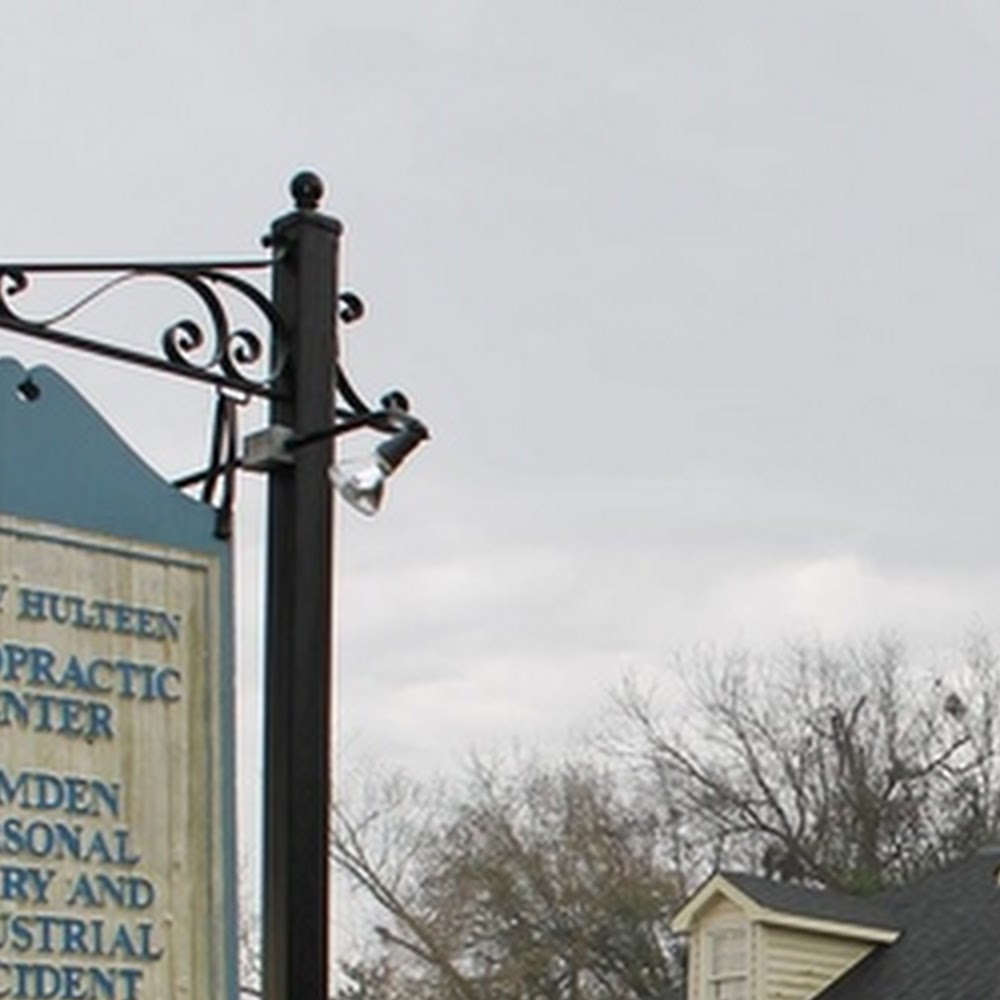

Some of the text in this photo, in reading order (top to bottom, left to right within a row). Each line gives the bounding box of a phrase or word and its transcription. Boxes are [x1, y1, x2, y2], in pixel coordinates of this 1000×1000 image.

[18, 587, 181, 641] HULTEEN
[0, 643, 181, 703] PRACTIC
[0, 689, 113, 741] NTER
[3, 818, 140, 866] SONAL
[0, 865, 155, 910] RY AND
